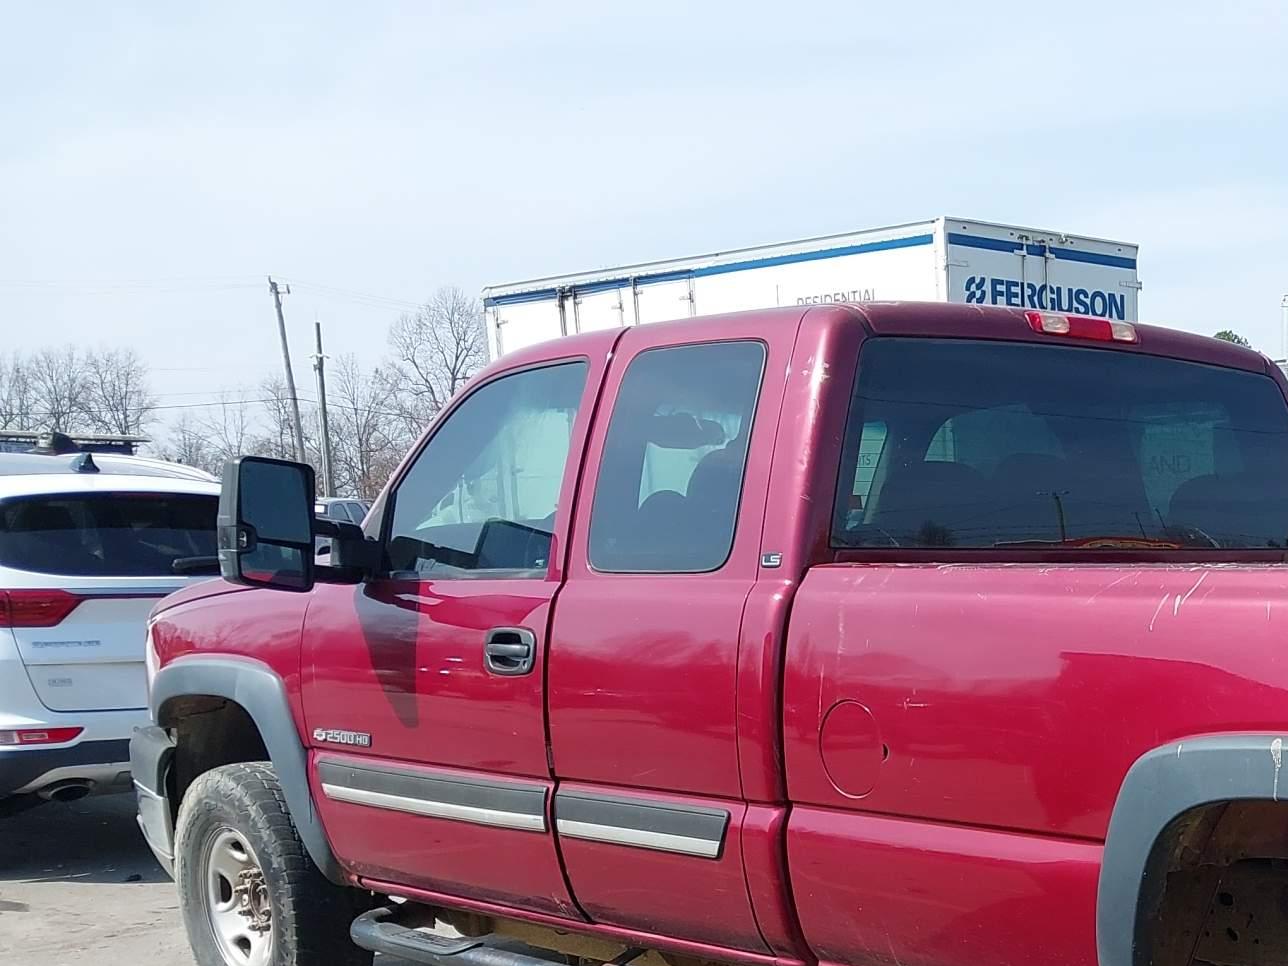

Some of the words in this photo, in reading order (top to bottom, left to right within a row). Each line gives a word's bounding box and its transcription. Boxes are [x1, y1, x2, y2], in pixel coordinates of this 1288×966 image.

[990, 278, 1125, 321] FERGUSON
[762, 553, 782, 566] LS
[327, 730, 354, 744] 2500
[356, 735, 368, 745] HD
